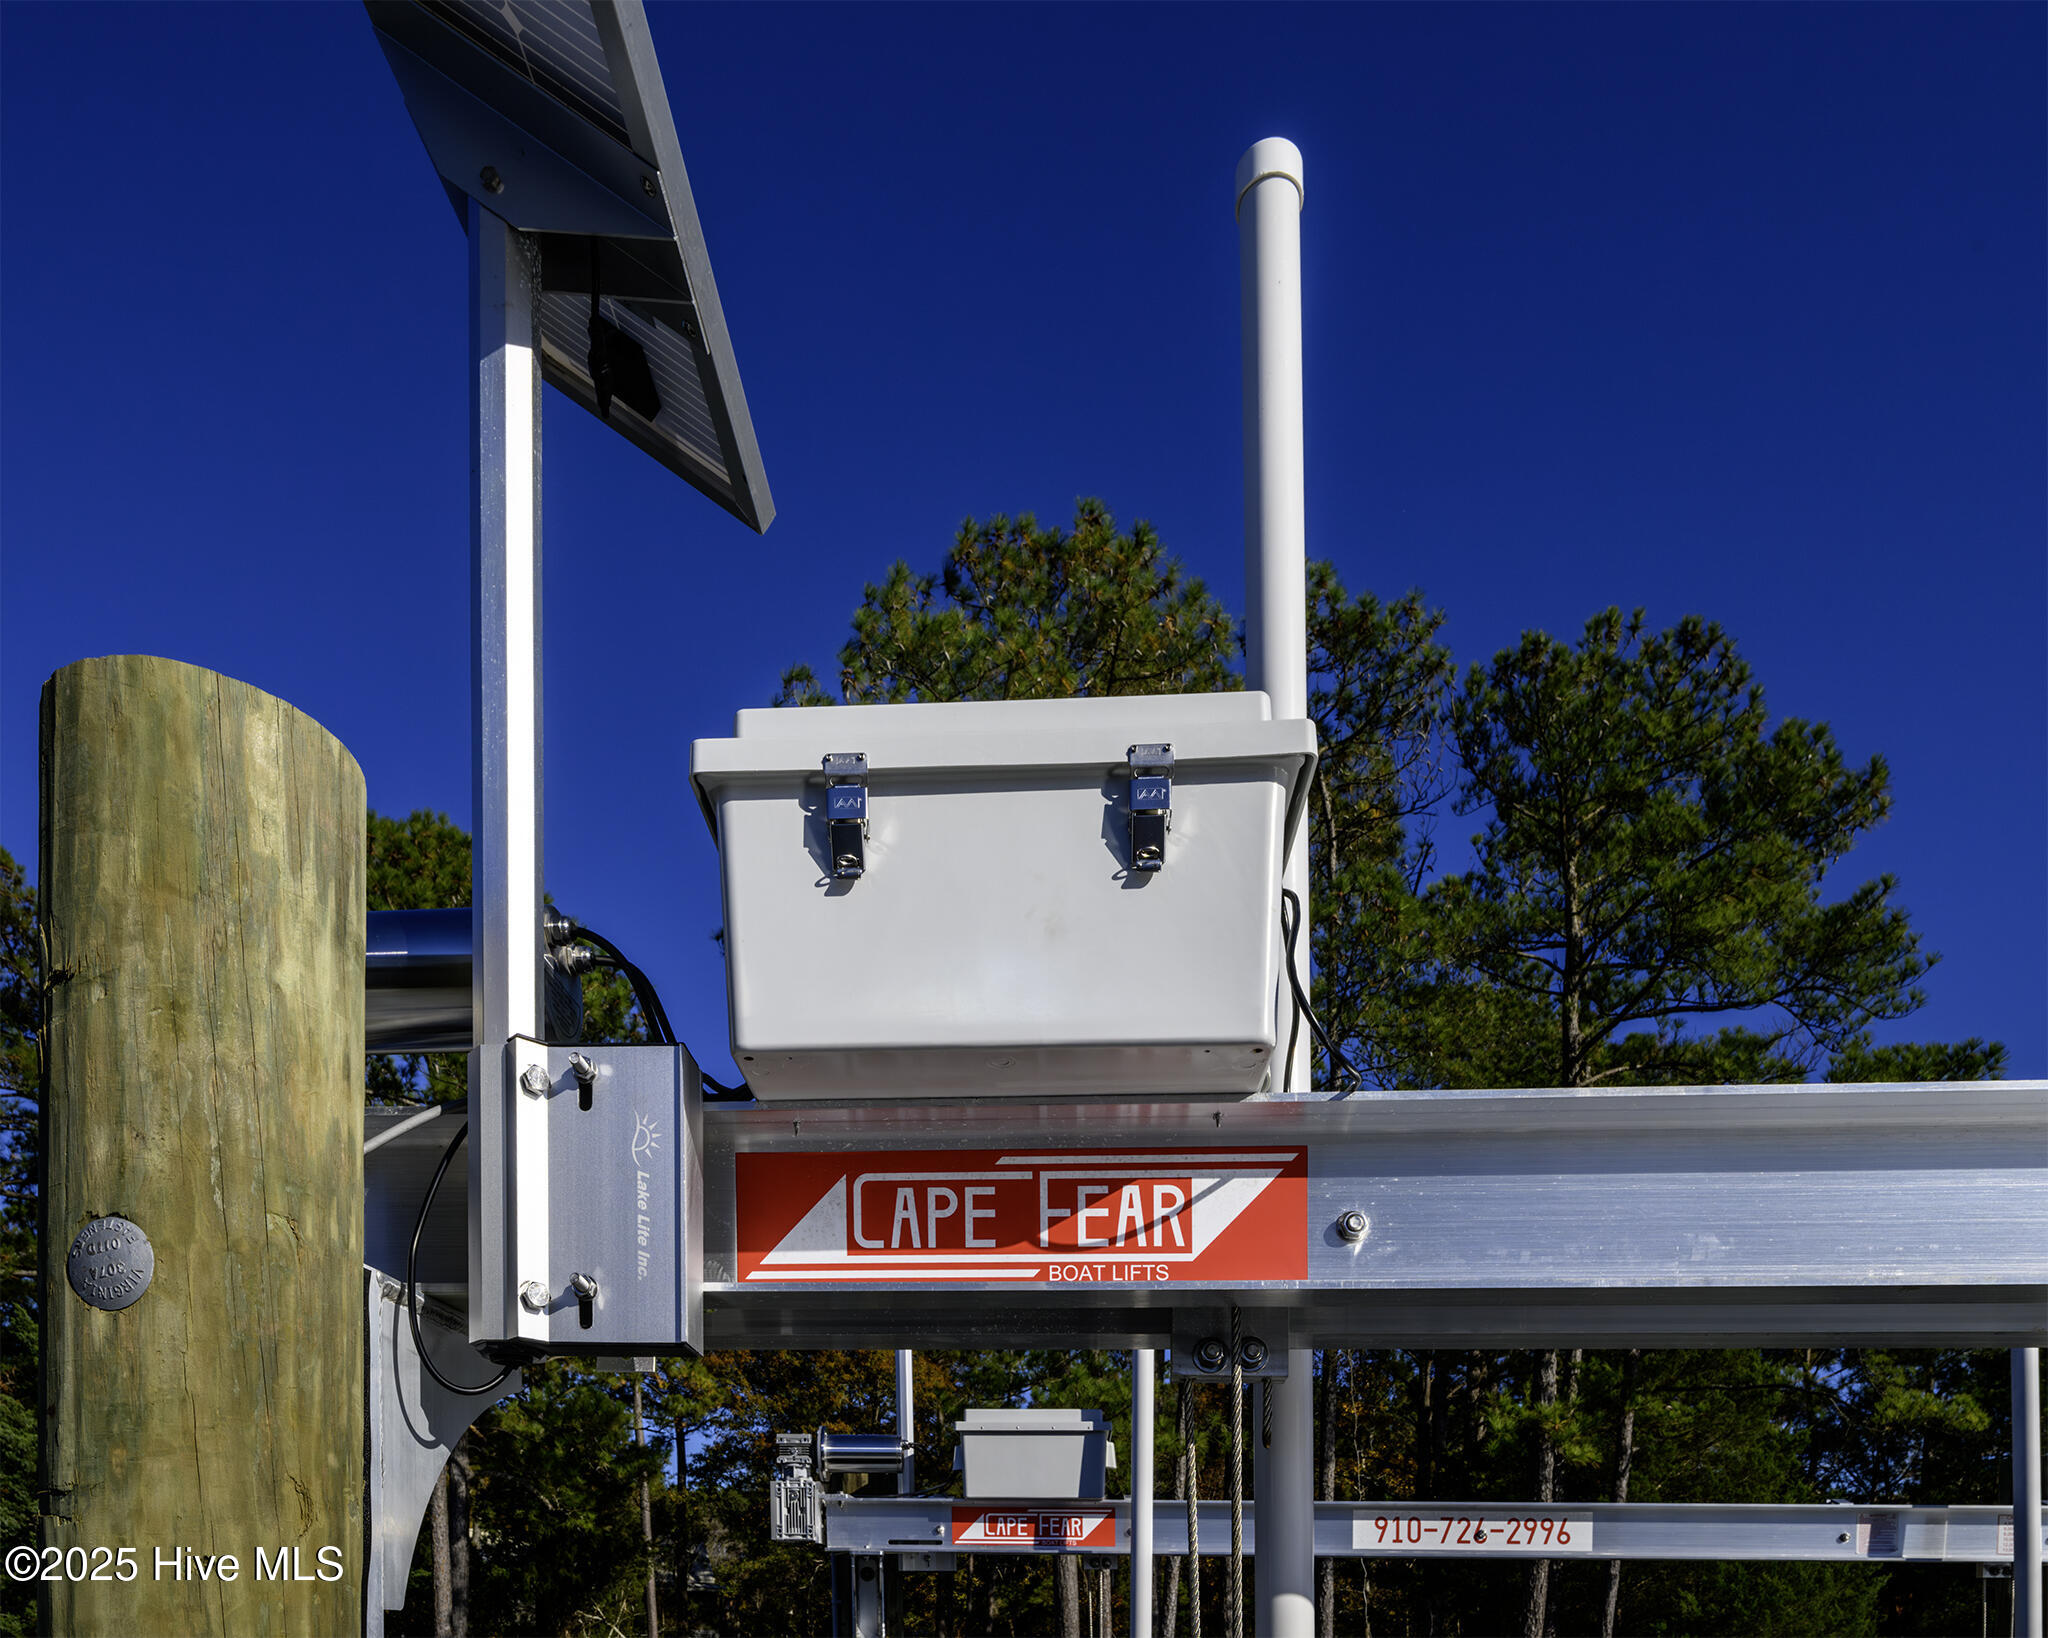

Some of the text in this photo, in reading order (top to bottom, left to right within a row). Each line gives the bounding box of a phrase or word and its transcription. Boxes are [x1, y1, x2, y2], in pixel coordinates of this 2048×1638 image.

[637, 1170, 650, 1210] Lake
[853, 1170, 1187, 1249] CAPE FEAR
[637, 1251, 650, 1281] Inc.
[1048, 1264, 1170, 1282] BOAT LIFTS
[985, 1513, 1082, 1537] CAPE FEAR
[1374, 1516, 1572, 1546] 910-726-2996
